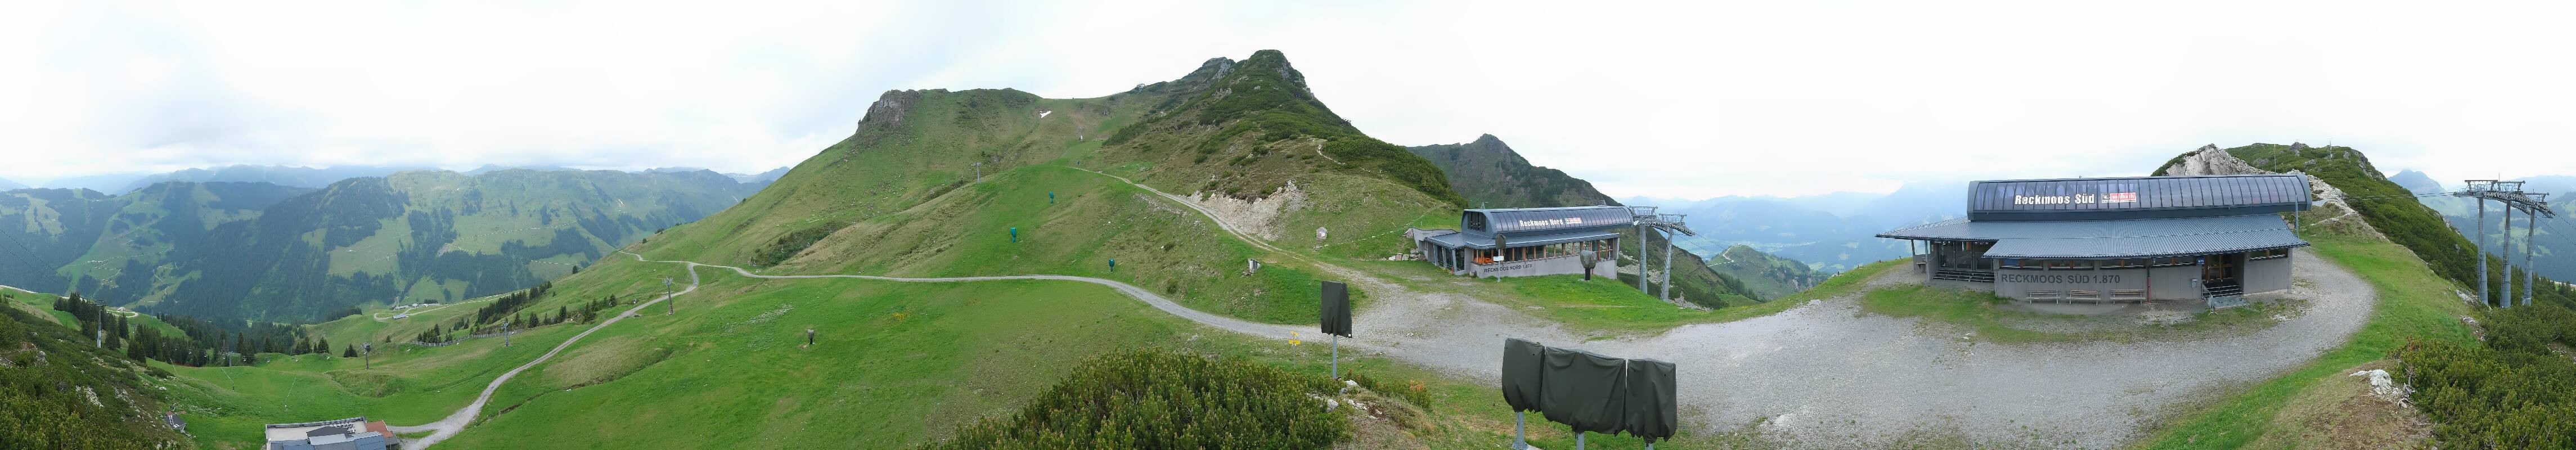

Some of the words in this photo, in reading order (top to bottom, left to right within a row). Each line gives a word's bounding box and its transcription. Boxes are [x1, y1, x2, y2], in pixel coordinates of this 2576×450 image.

[2015, 195, 2070, 205] Reckmoos
[2075, 194, 2094, 204] Süd
[2001, 274, 2062, 284] RECKMOOS
[2067, 274, 2089, 284] SÜD
[2093, 274, 2120, 284] 1.870
